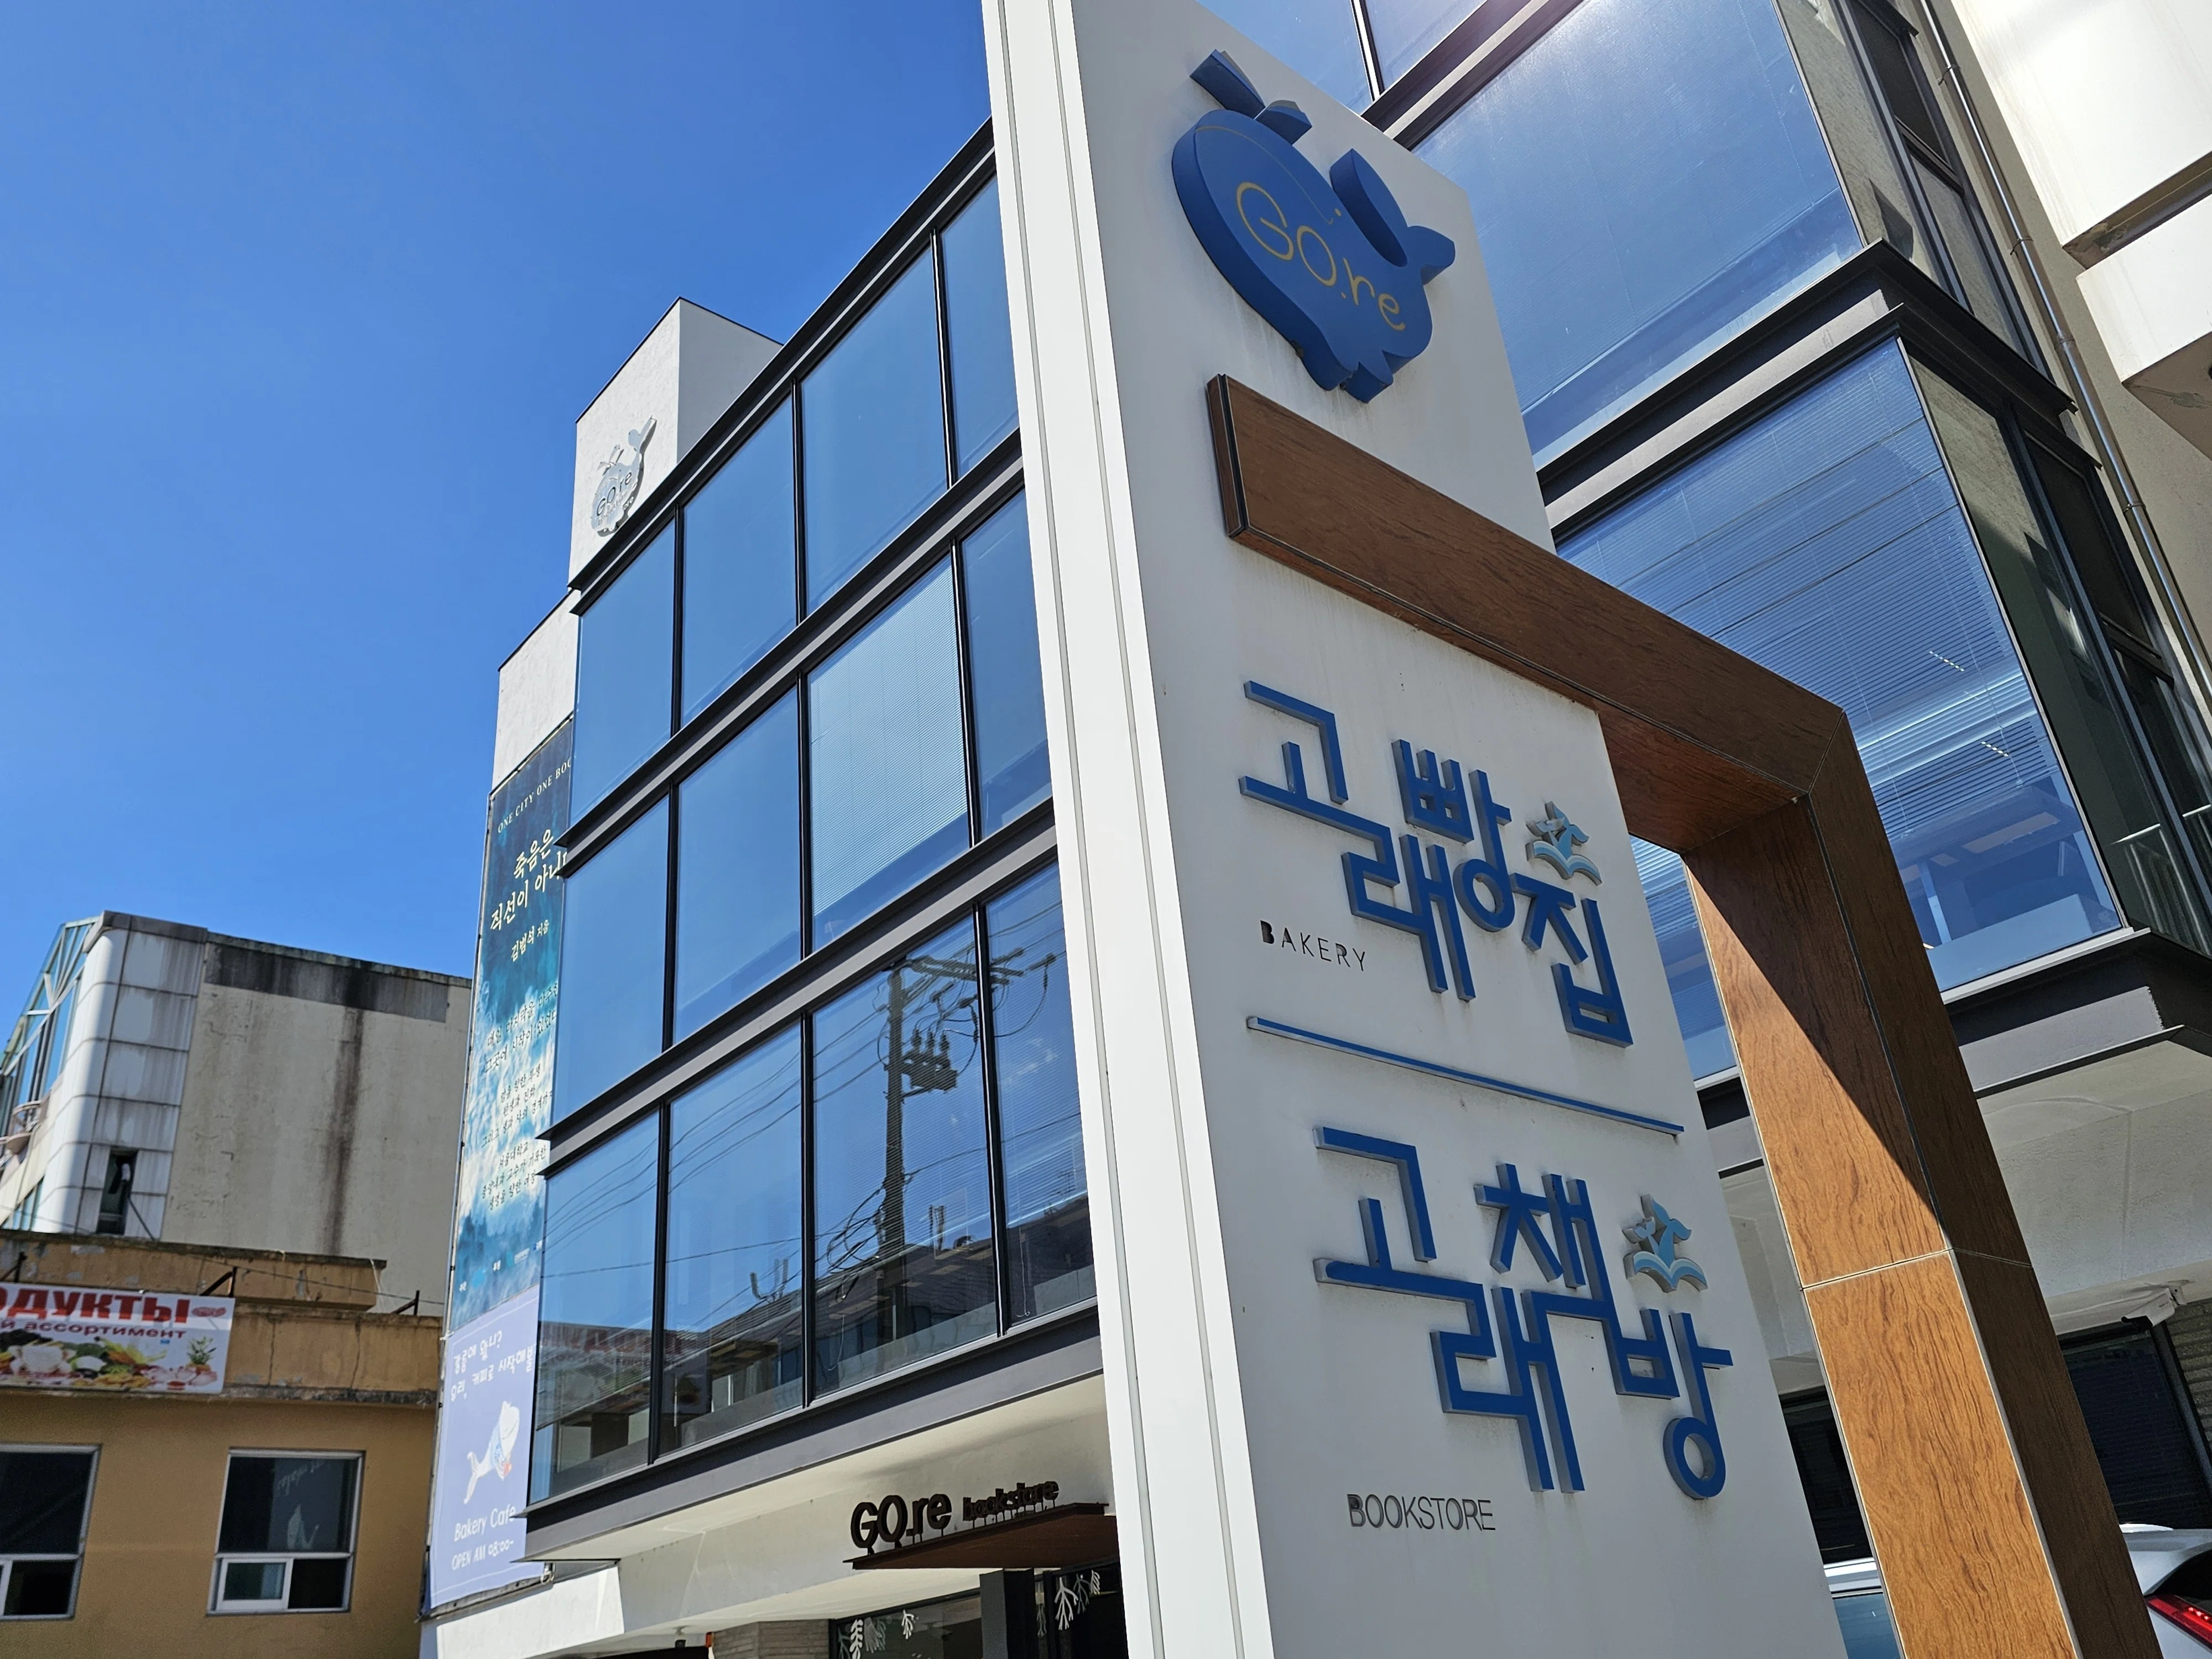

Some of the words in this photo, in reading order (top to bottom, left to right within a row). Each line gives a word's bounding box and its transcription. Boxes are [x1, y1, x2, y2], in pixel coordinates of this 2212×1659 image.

[1237, 181, 1405, 331] GO.re
[498, 812, 513, 833] ONE
[515, 791, 534, 816] CITY
[536, 775, 552, 795] ONE
[555, 757, 571, 779] BOO
[513, 830, 554, 879] 죽음은
[491, 879, 528, 930] 직선이
[535, 851, 567, 893] 아니
[510, 926, 535, 962] 김범석
[536, 920, 550, 937] 지음
[1260, 920, 1366, 972] BAKERY
[488, 1025, 502, 1046] 매일
[506, 1001, 535, 1032] 마지막을
[485, 1044, 508, 1073] 그곳에
[512, 1024, 533, 1052] 시작이
[482, 1128, 499, 1147] 그리고
[500, 1141, 529, 1167] 서울대학교
[507, 1159, 526, 1181] 교수가
[0, 1287, 190, 1323] ДУКТЫ
[24, 1322, 186, 1338] ассортимент
[963, 1481, 1060, 1521] bookstore
[1347, 1493, 1496, 1530] BOOKSTORE
[454, 1516, 487, 1542] Bakery
[490, 1504, 517, 1528] Cafe
[452, 1550, 472, 1571] OPEN
[473, 1545, 486, 1562] AM
